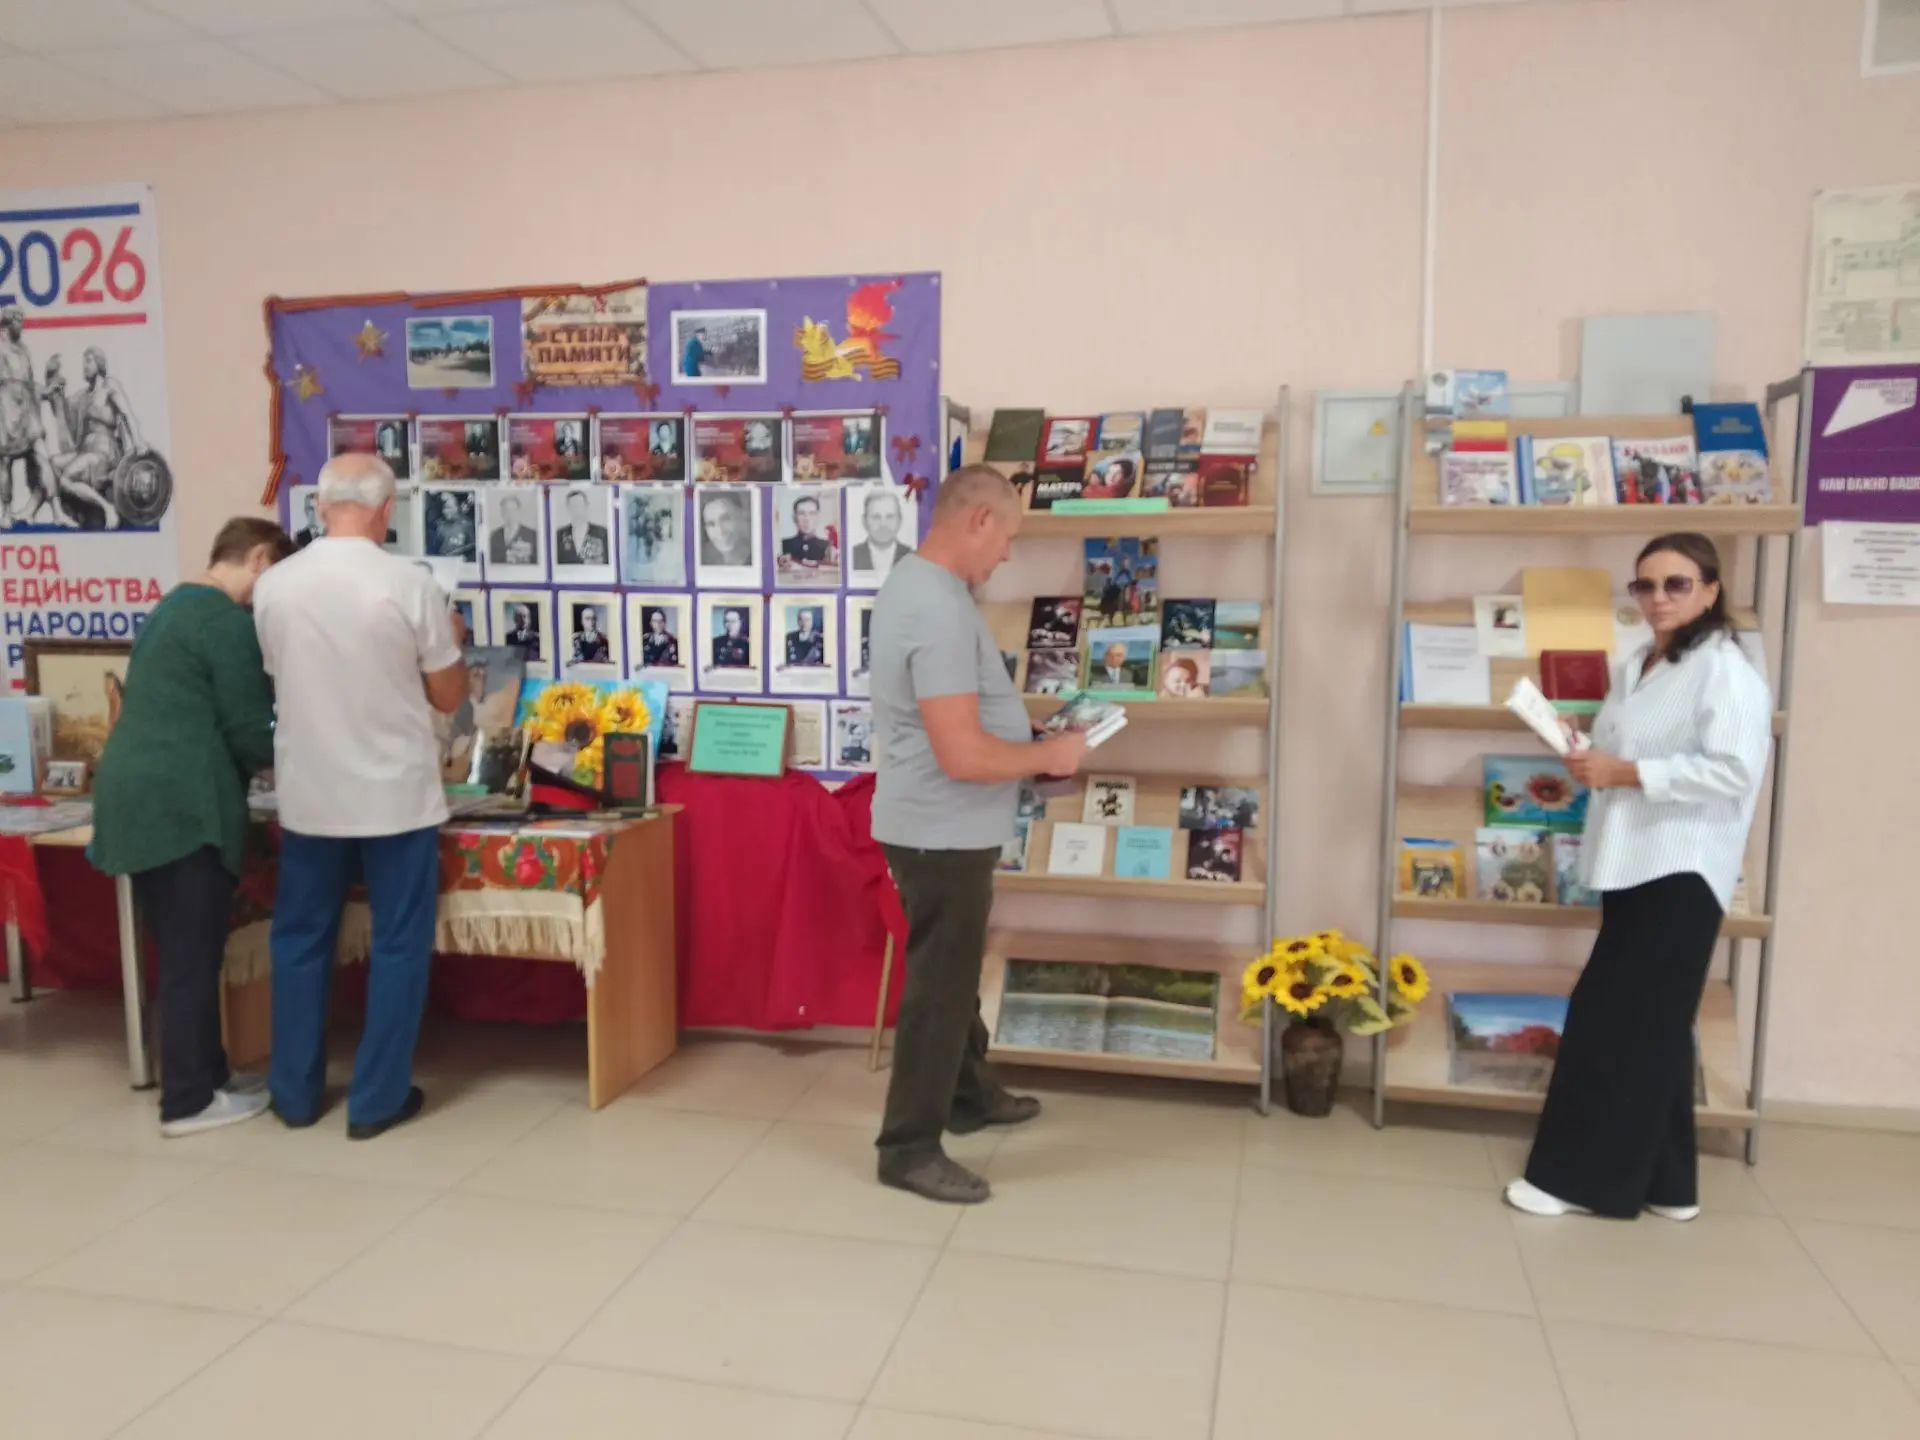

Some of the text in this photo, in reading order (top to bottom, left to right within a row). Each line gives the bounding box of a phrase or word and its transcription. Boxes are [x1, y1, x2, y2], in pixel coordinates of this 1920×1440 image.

[550, 325, 620, 344] СТЕНА
[537, 344, 632, 363] ПАМЯТИ
[1, 545, 60, 573] ГОД
[3, 577, 163, 607] ЕДИНСТВА
